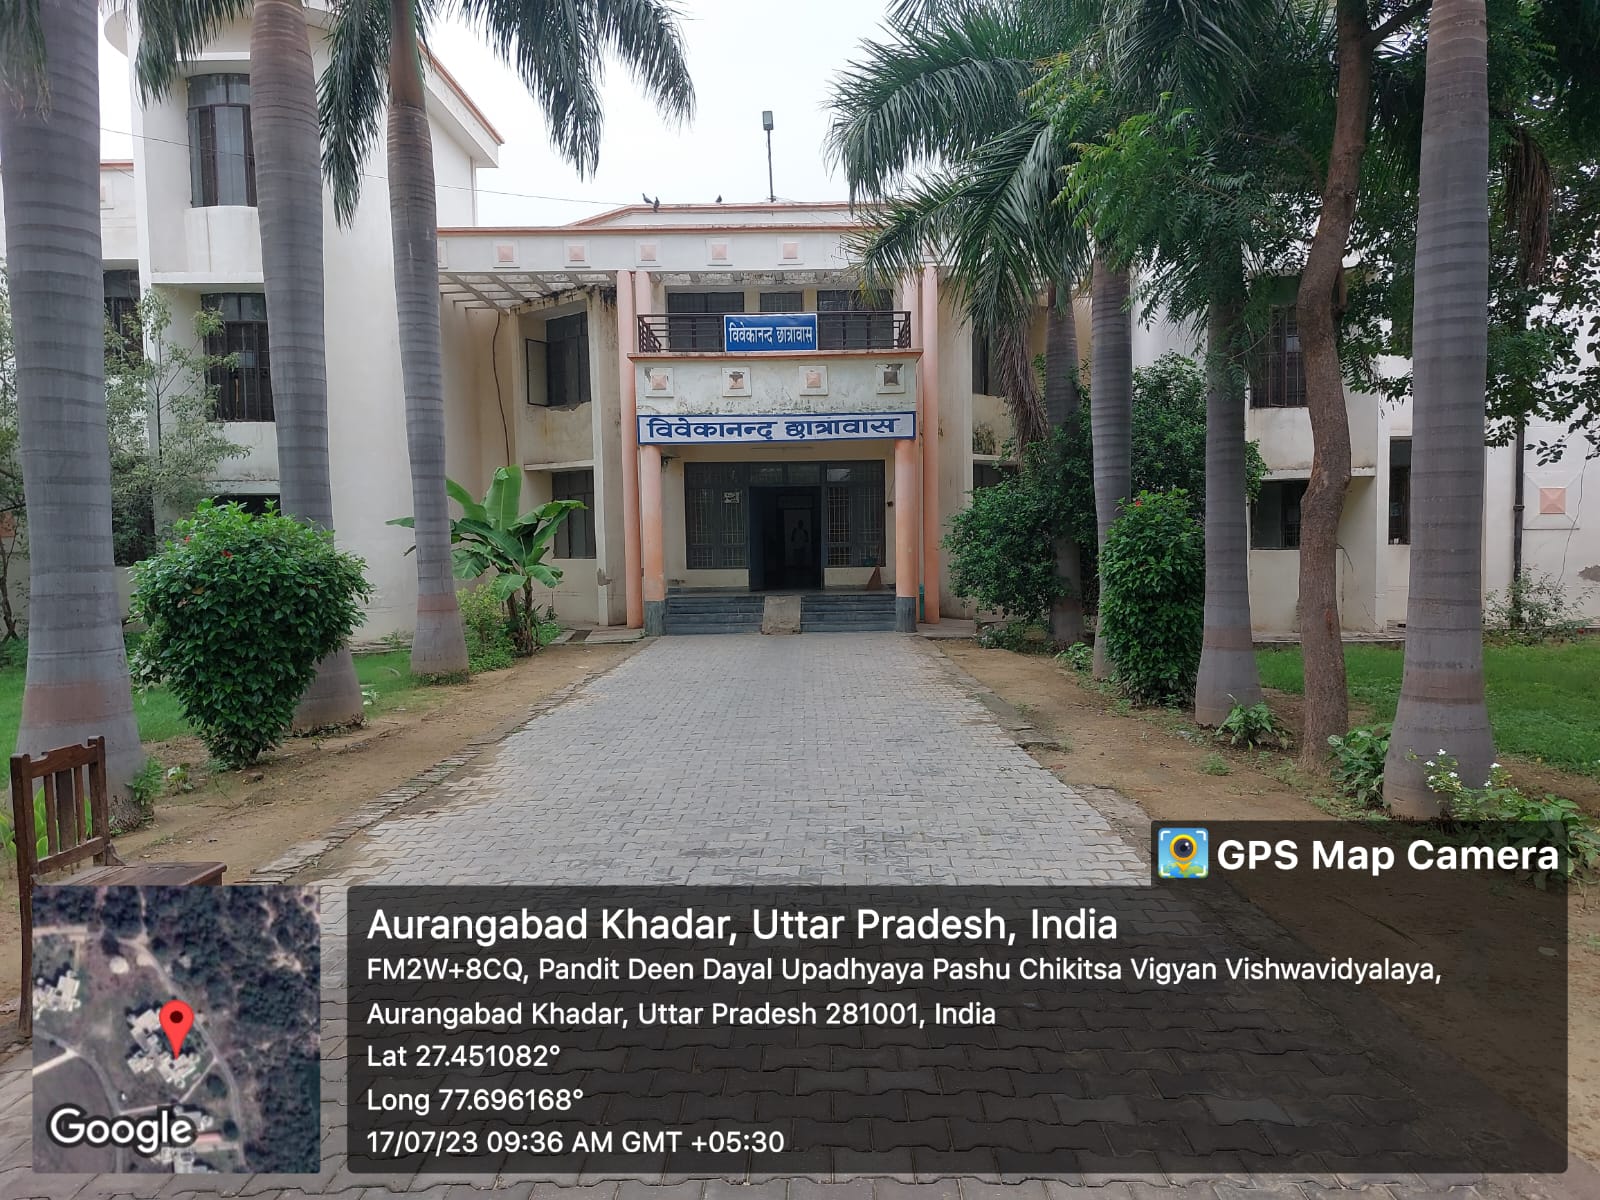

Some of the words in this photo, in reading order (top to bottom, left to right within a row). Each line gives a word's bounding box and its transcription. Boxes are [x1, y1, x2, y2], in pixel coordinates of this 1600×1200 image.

[729, 321, 773, 344] विवेकानन्द
[776, 326, 813, 344] छात्रावास
[646, 418, 778, 440] विवेकानन्द
[785, 417, 901, 439] छात्रावास
